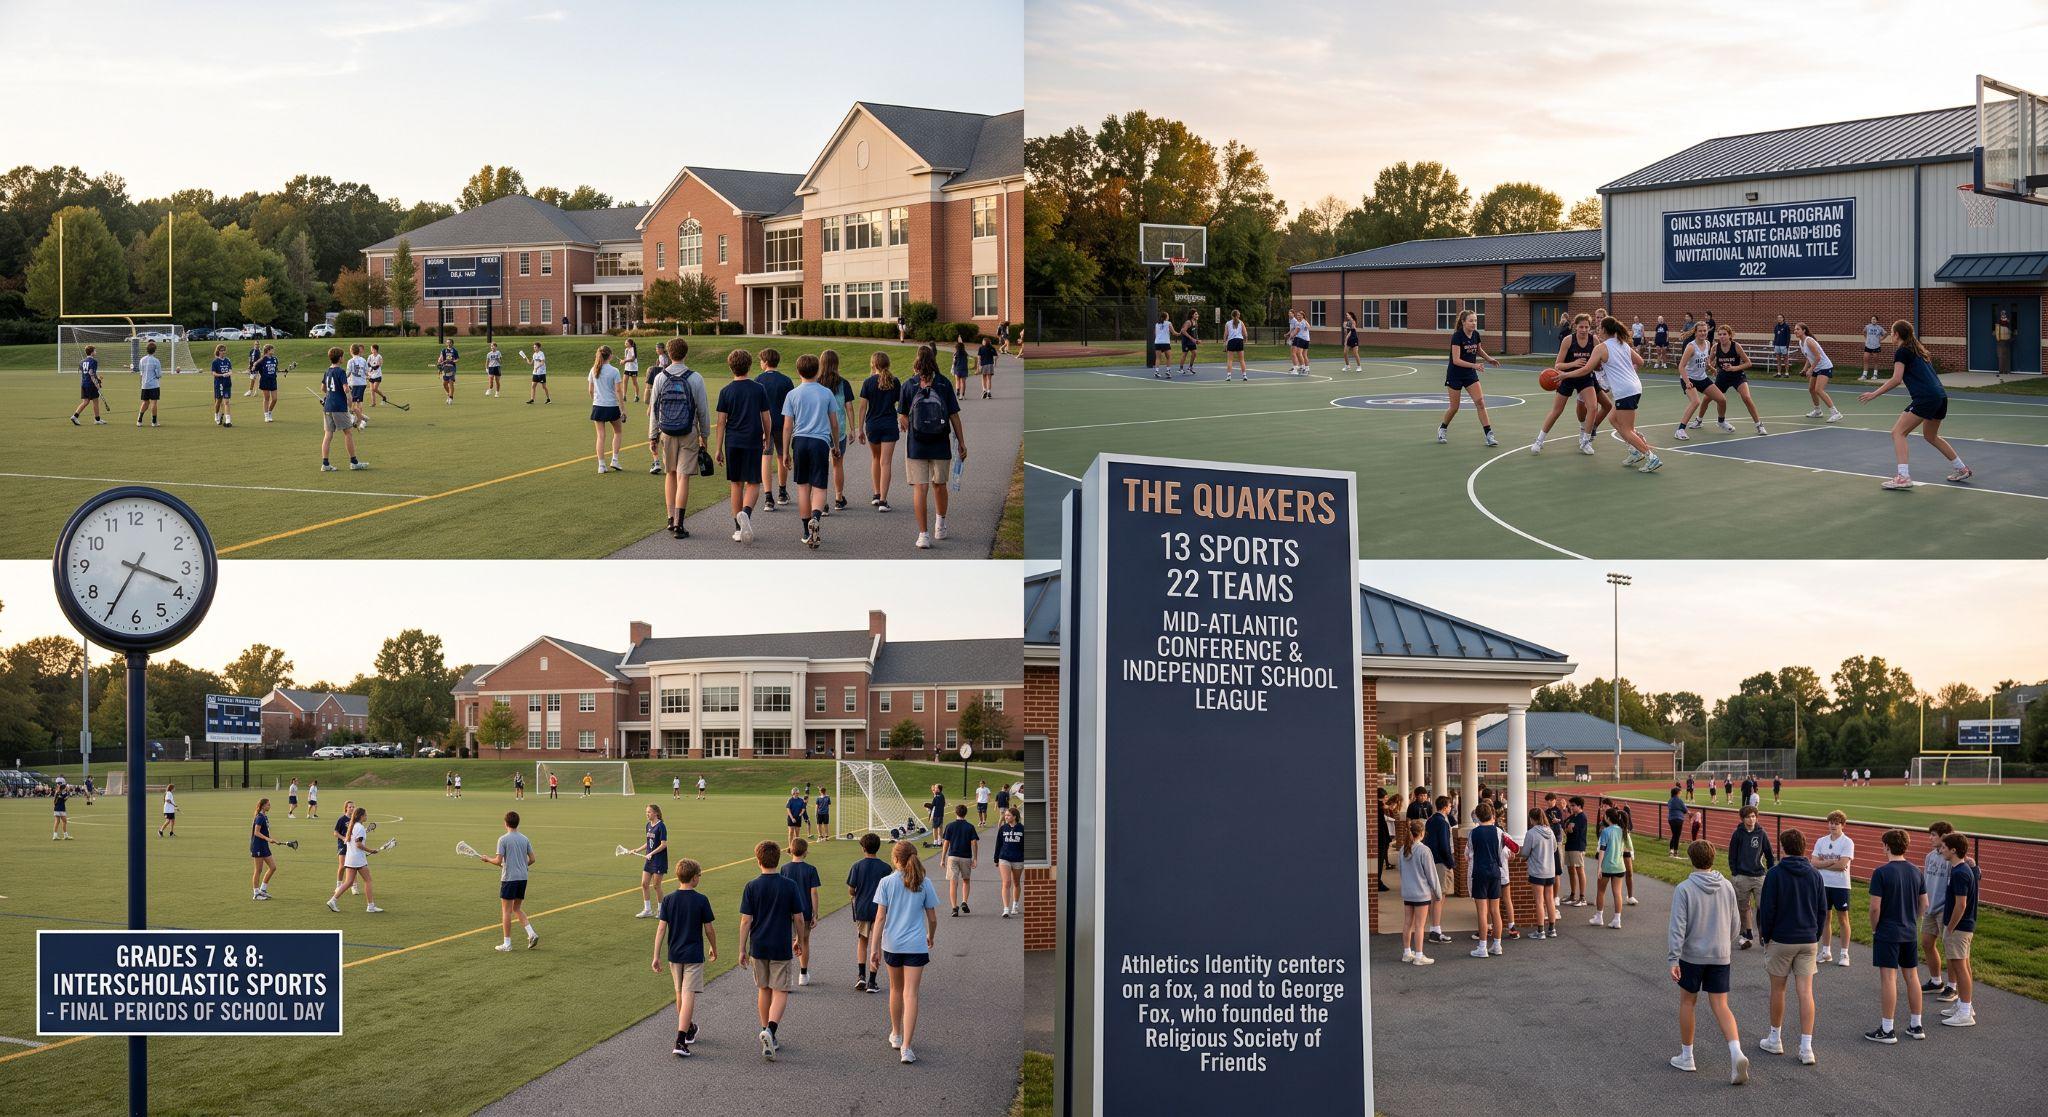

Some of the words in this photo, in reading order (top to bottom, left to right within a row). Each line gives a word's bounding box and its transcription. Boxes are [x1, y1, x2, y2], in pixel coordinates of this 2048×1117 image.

[1705, 211, 1776, 229] BASKETBALL
[1780, 205, 1844, 223] PROGRAM
[1673, 232, 1731, 247] DIANGURAL
[1734, 228, 1766, 244] STATE
[1675, 246, 1744, 262] INVITATIONAL
[1747, 244, 1802, 259] NATIONAL
[1806, 242, 1839, 257] TITLE
[1739, 262, 1766, 276] 2022
[1123, 478, 1181, 514] THE
[1194, 484, 1335, 524] QUAKERS
[105, 518, 118, 532] 11
[128, 511, 144, 526] 12
[157, 518, 163, 533] 1
[88, 536, 104, 551] 10
[174, 536, 184, 551] 2
[1161, 532, 1190, 560] 13
[1200, 535, 1299, 567] SPORTS
[80, 559, 90, 574] 9
[181, 561, 191, 576] 3
[88, 584, 98, 599] 8
[173, 586, 184, 600] 4
[1167, 569, 1199, 597] 22
[1208, 571, 1293, 602] TEAMS
[131, 609, 142, 624] 6
[156, 603, 167, 618] 5
[1163, 610, 1298, 638] MID-ATLANTIC
[1157, 636, 1282, 661] CONFERENCE
[1289, 642, 1302, 662] &
[1123, 659, 1254, 685] INDEPENDENT
[1261, 665, 1338, 689] SCHOOL
[1196, 688, 1267, 711] LEAGUE
[117, 945, 196, 967] GRADES
[205, 945, 215, 967] 7
[224, 945, 237, 967] &
[246, 945, 263, 967] 8:
[1121, 955, 1198, 973] Athletics
[1206, 954, 1272, 977] Identity
[1278, 956, 1344, 973] centers
[54, 973, 239, 995] INTERSCHOLASTIC
[247, 973, 326, 995] SPORTS
[1123, 984, 1143, 998] on
[1150, 984, 1159, 998] a
[1165, 979, 1197, 1001] fox,
[1204, 984, 1213, 998] a
[1221, 979, 1252, 998] nod
[1258, 980, 1275, 998] to
[1282, 979, 1343, 1002] George
[61, 1002, 108, 1020] FINAL
[194, 1002, 215, 1020] OF
[221, 1002, 287, 1020] SCHOOL
[294, 1002, 324, 1020] DAY
[1139, 1004, 1174, 1026] Fox,
[1181, 1004, 1216, 1022] who
[1222, 1004, 1294, 1023] founded
[1300, 1004, 1328, 1022] the
[1146, 1028, 1227, 1051] Religious
[1234, 1028, 1298, 1051] Society
[1305, 1028, 1321, 1047] of
[1201, 1053, 1266, 1071] Friends
